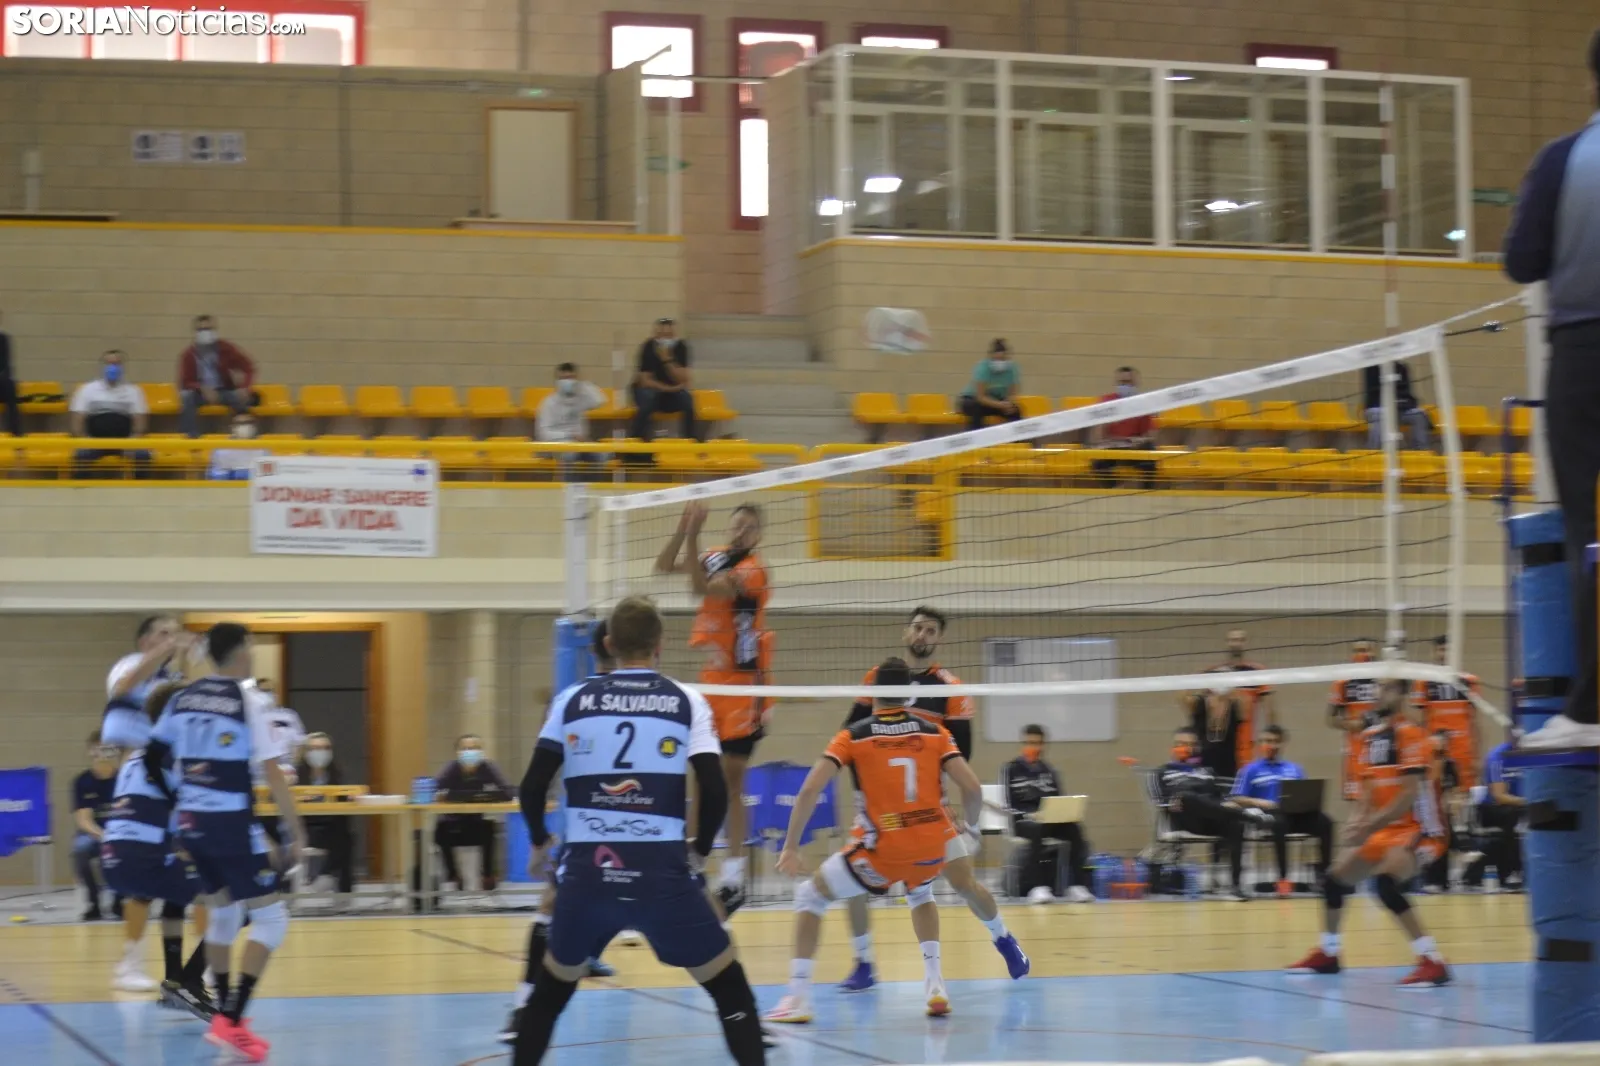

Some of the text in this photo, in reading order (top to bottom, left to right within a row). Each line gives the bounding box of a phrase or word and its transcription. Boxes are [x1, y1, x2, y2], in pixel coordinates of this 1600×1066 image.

[579, 693, 681, 714] M. SALVADOR
[612, 721, 635, 769] 2
[887, 757, 918, 803] 7
